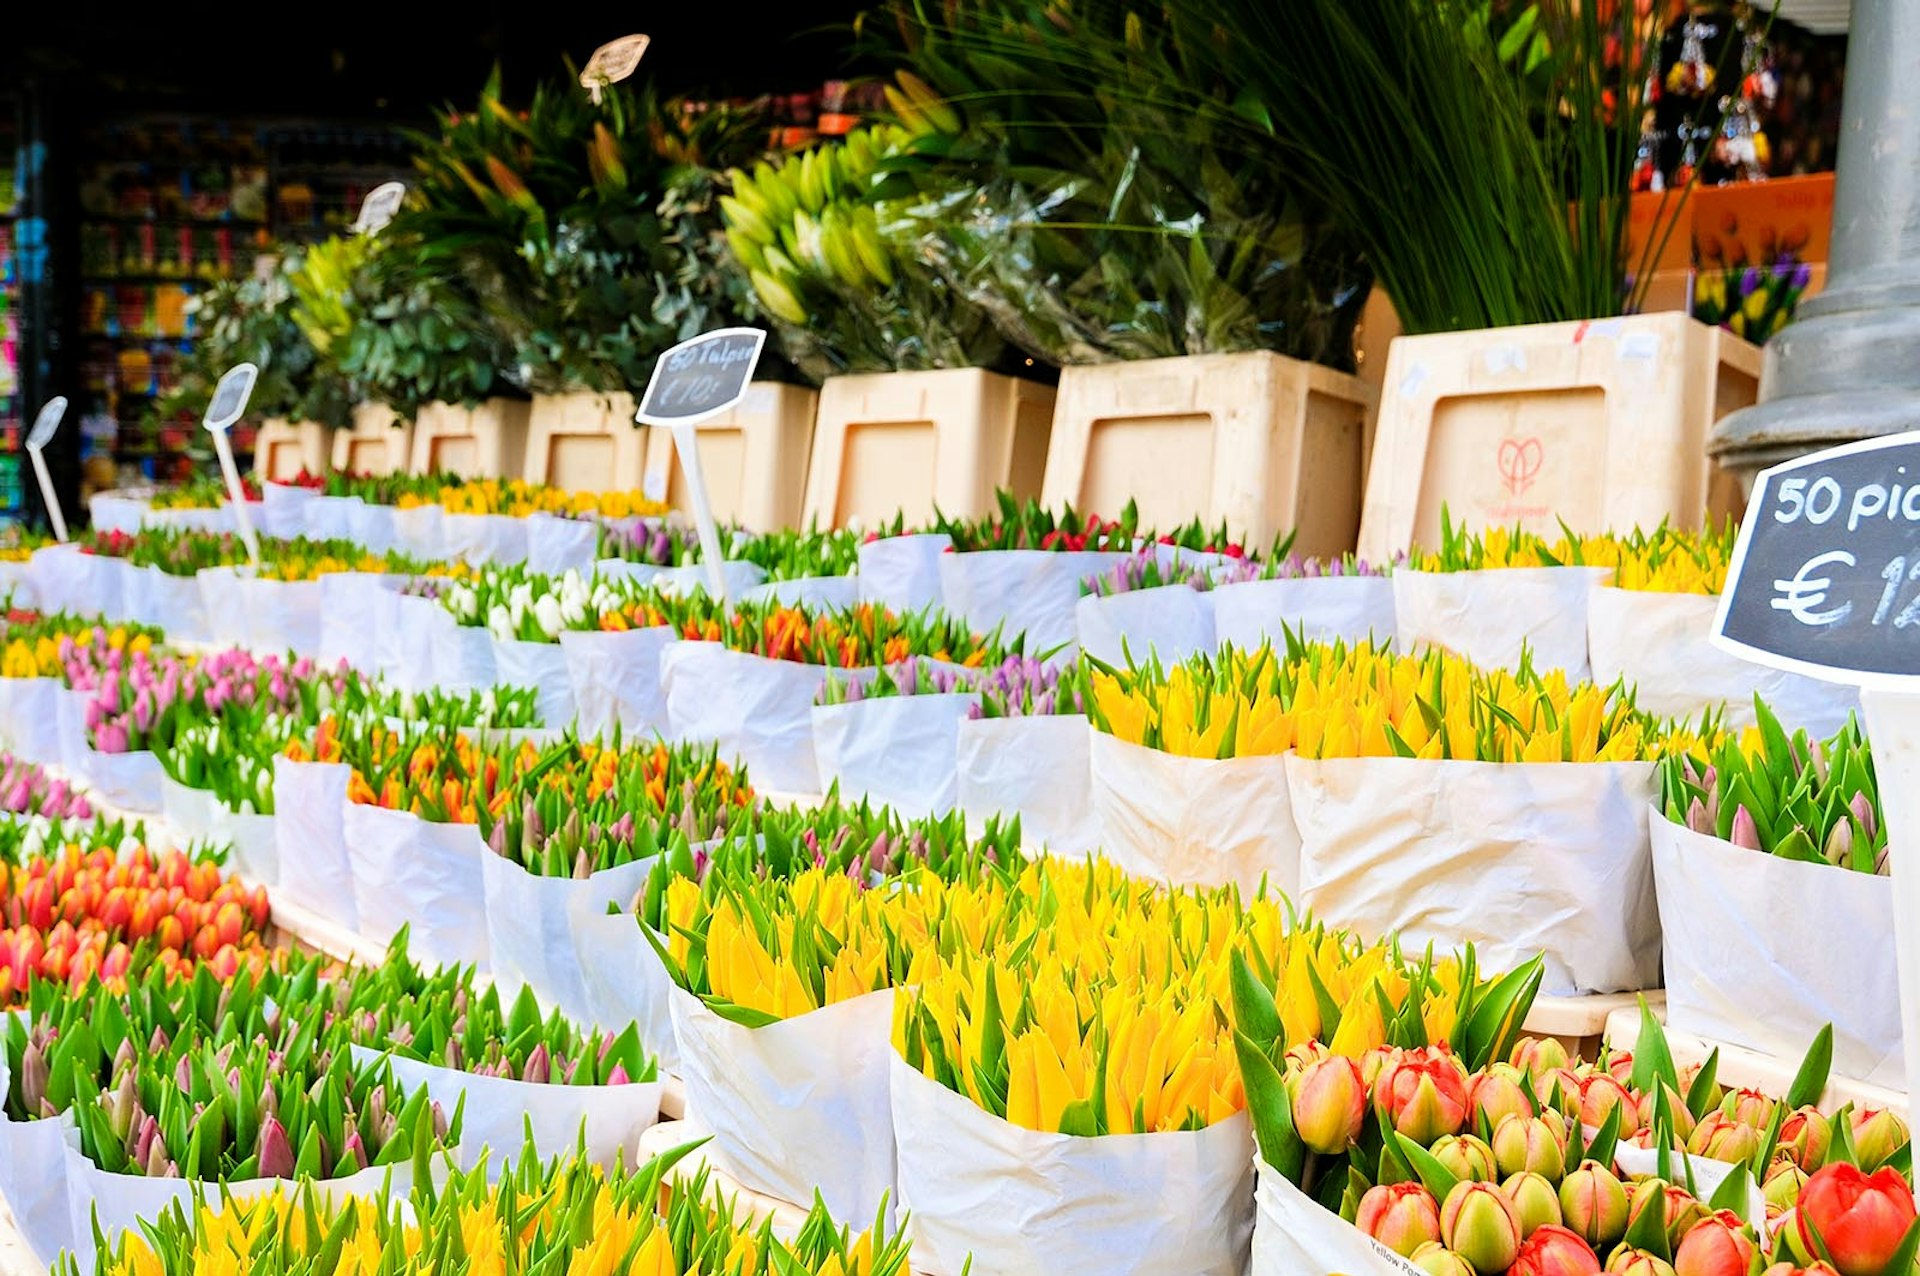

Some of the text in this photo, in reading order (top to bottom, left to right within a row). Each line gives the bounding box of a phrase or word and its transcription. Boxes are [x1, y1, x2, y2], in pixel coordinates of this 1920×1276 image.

[667, 348, 697, 373] 50
[1775, 476, 1842, 525] 50
[1771, 550, 1856, 625] €
[1370, 1240, 1400, 1267] Yellow
